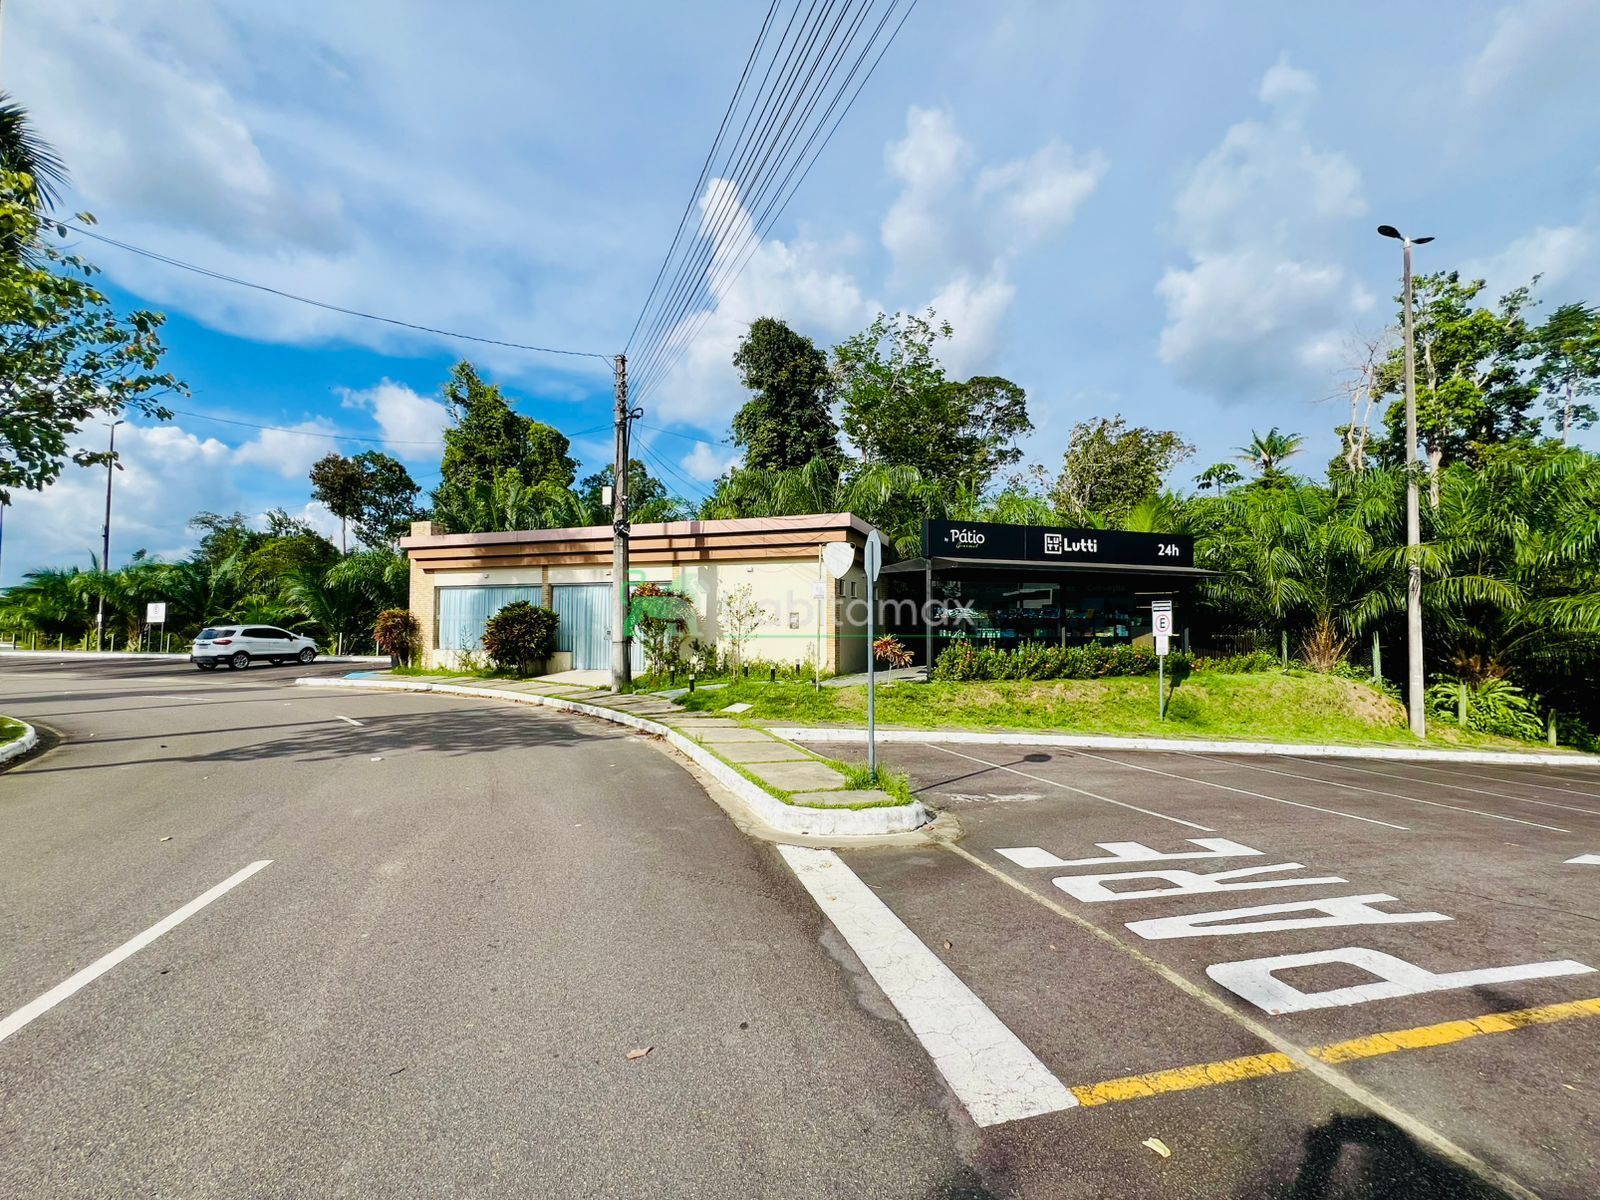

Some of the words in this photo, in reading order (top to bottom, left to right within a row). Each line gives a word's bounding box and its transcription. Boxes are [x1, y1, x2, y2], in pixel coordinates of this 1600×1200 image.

[949, 528, 986, 544] Pátio
[1064, 537, 1098, 553] Lutti
[1157, 543, 1180, 557] 24h
[1160, 617, 1166, 629] E
[993, 837, 1599, 1015] PARE
